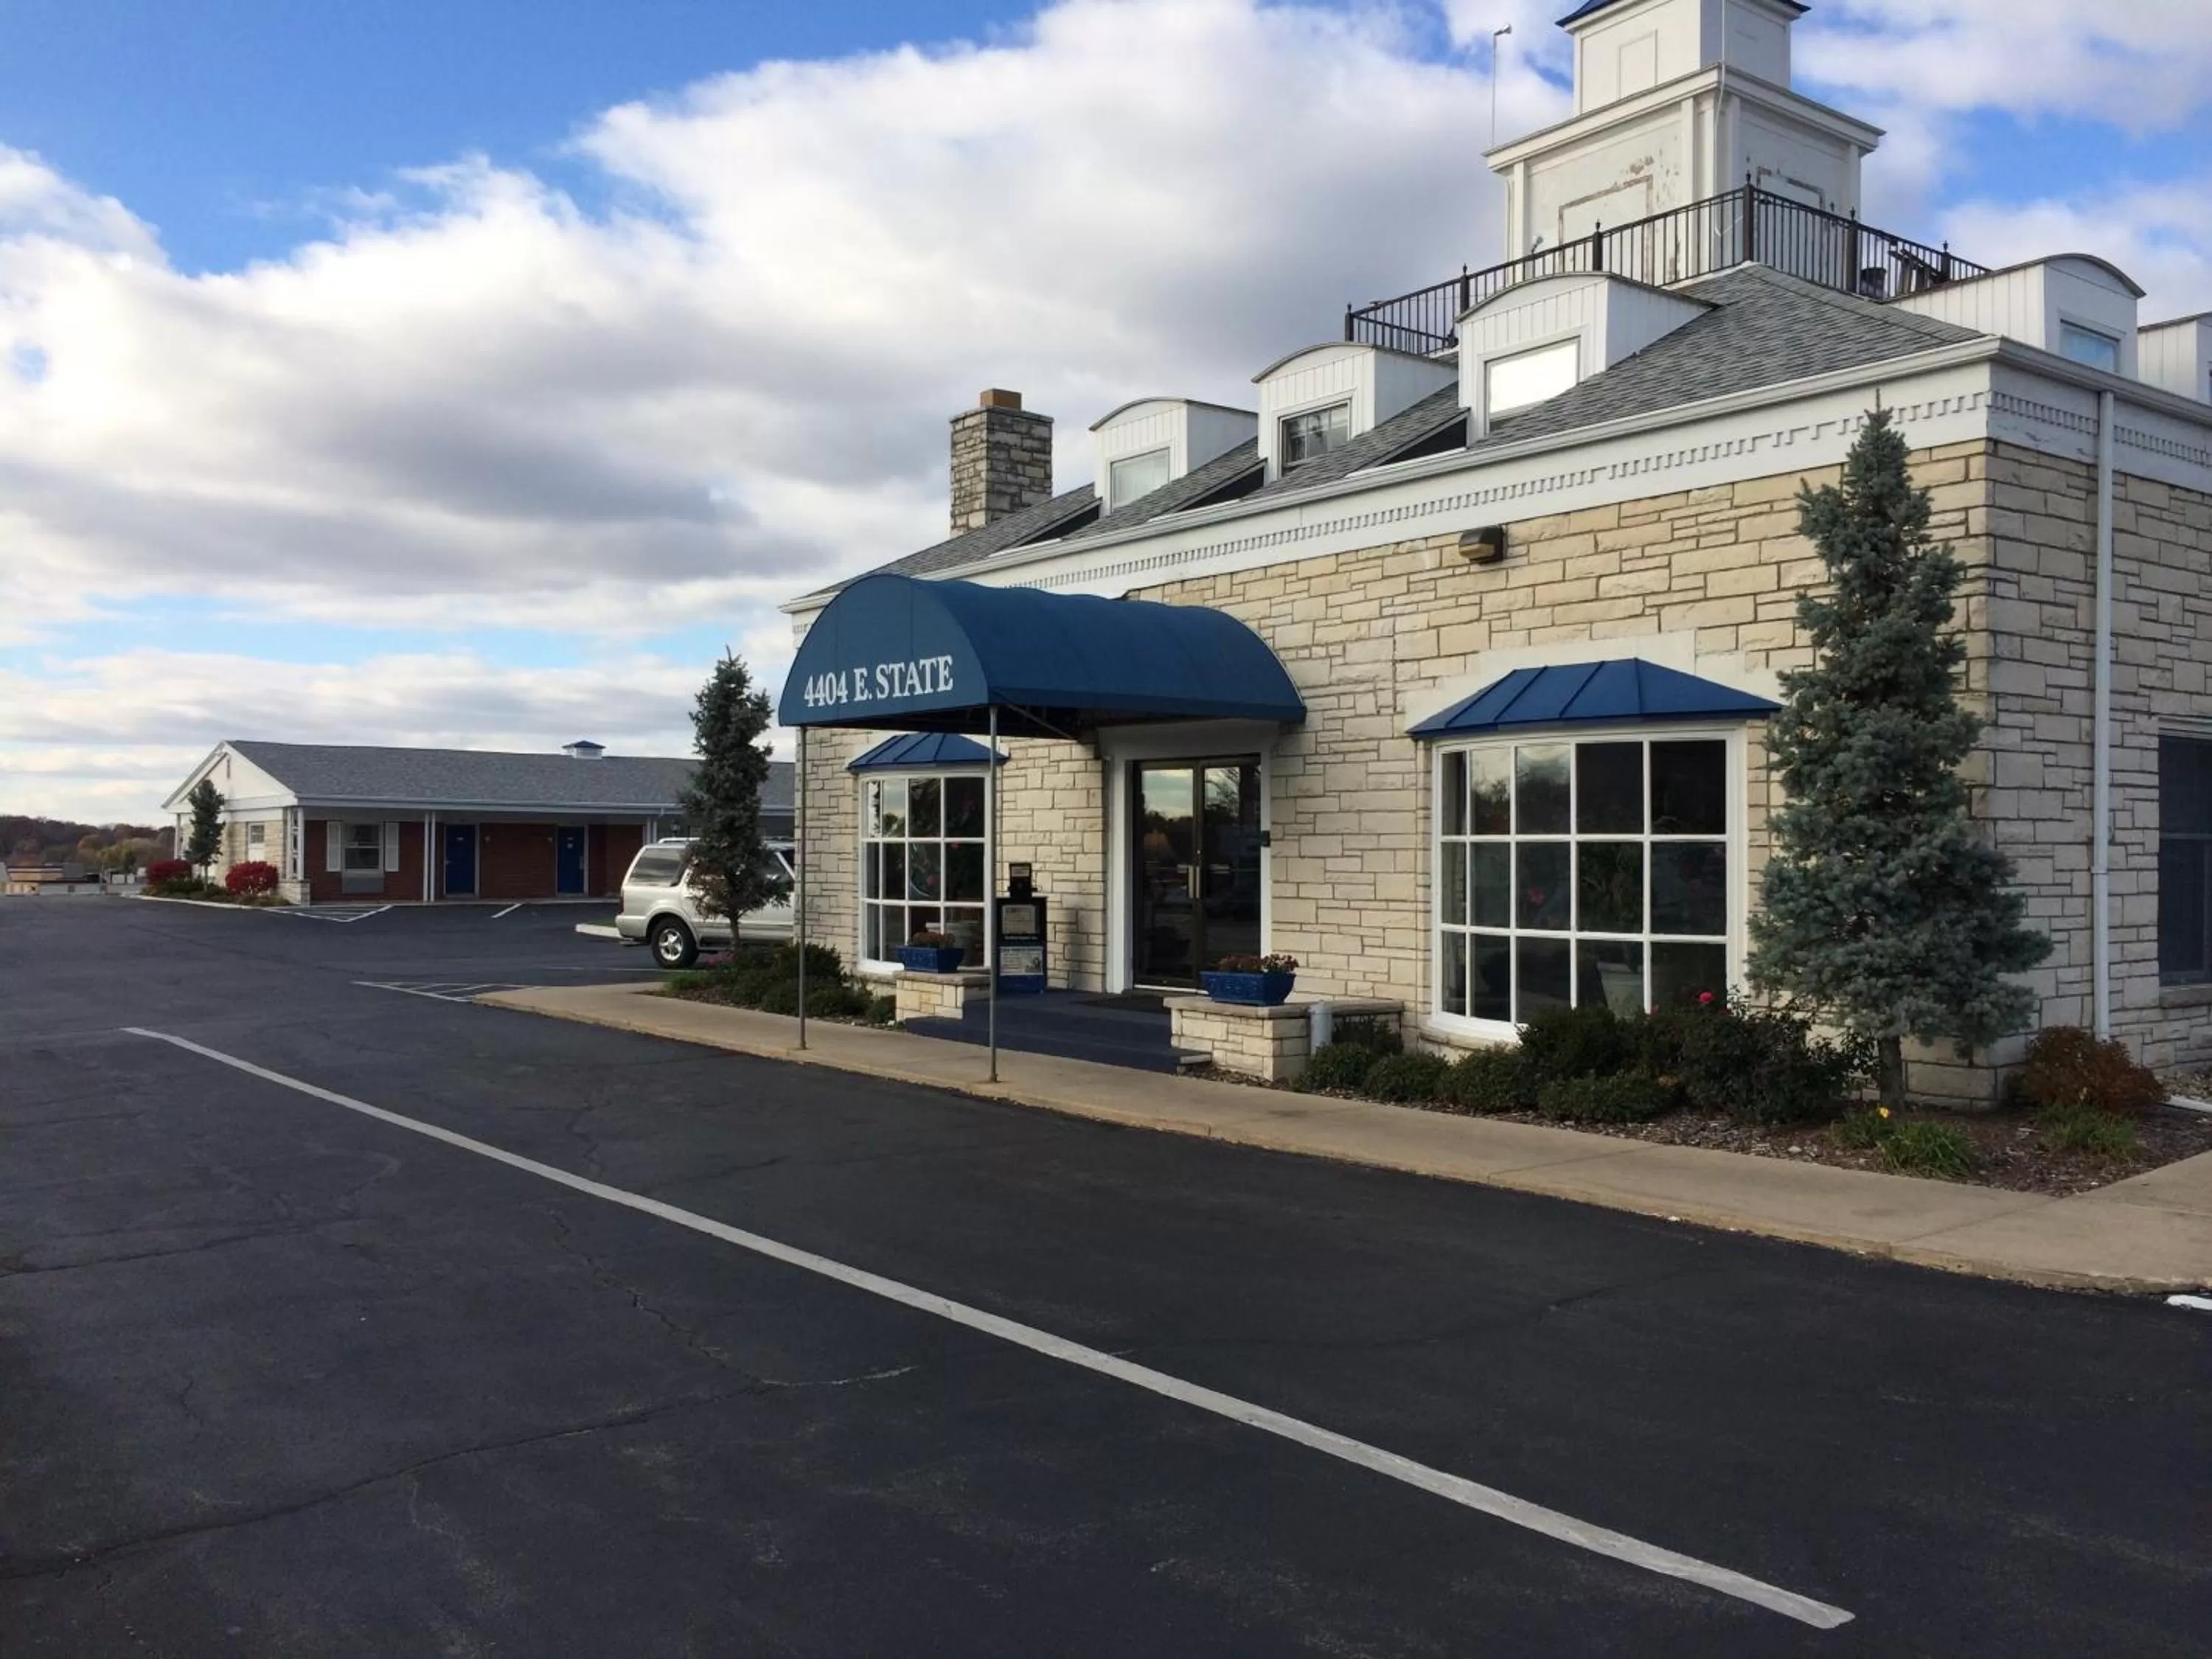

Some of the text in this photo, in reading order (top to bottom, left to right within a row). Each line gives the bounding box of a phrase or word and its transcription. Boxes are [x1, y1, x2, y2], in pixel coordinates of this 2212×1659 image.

[804, 655, 953, 707] 4404 E. STATE
